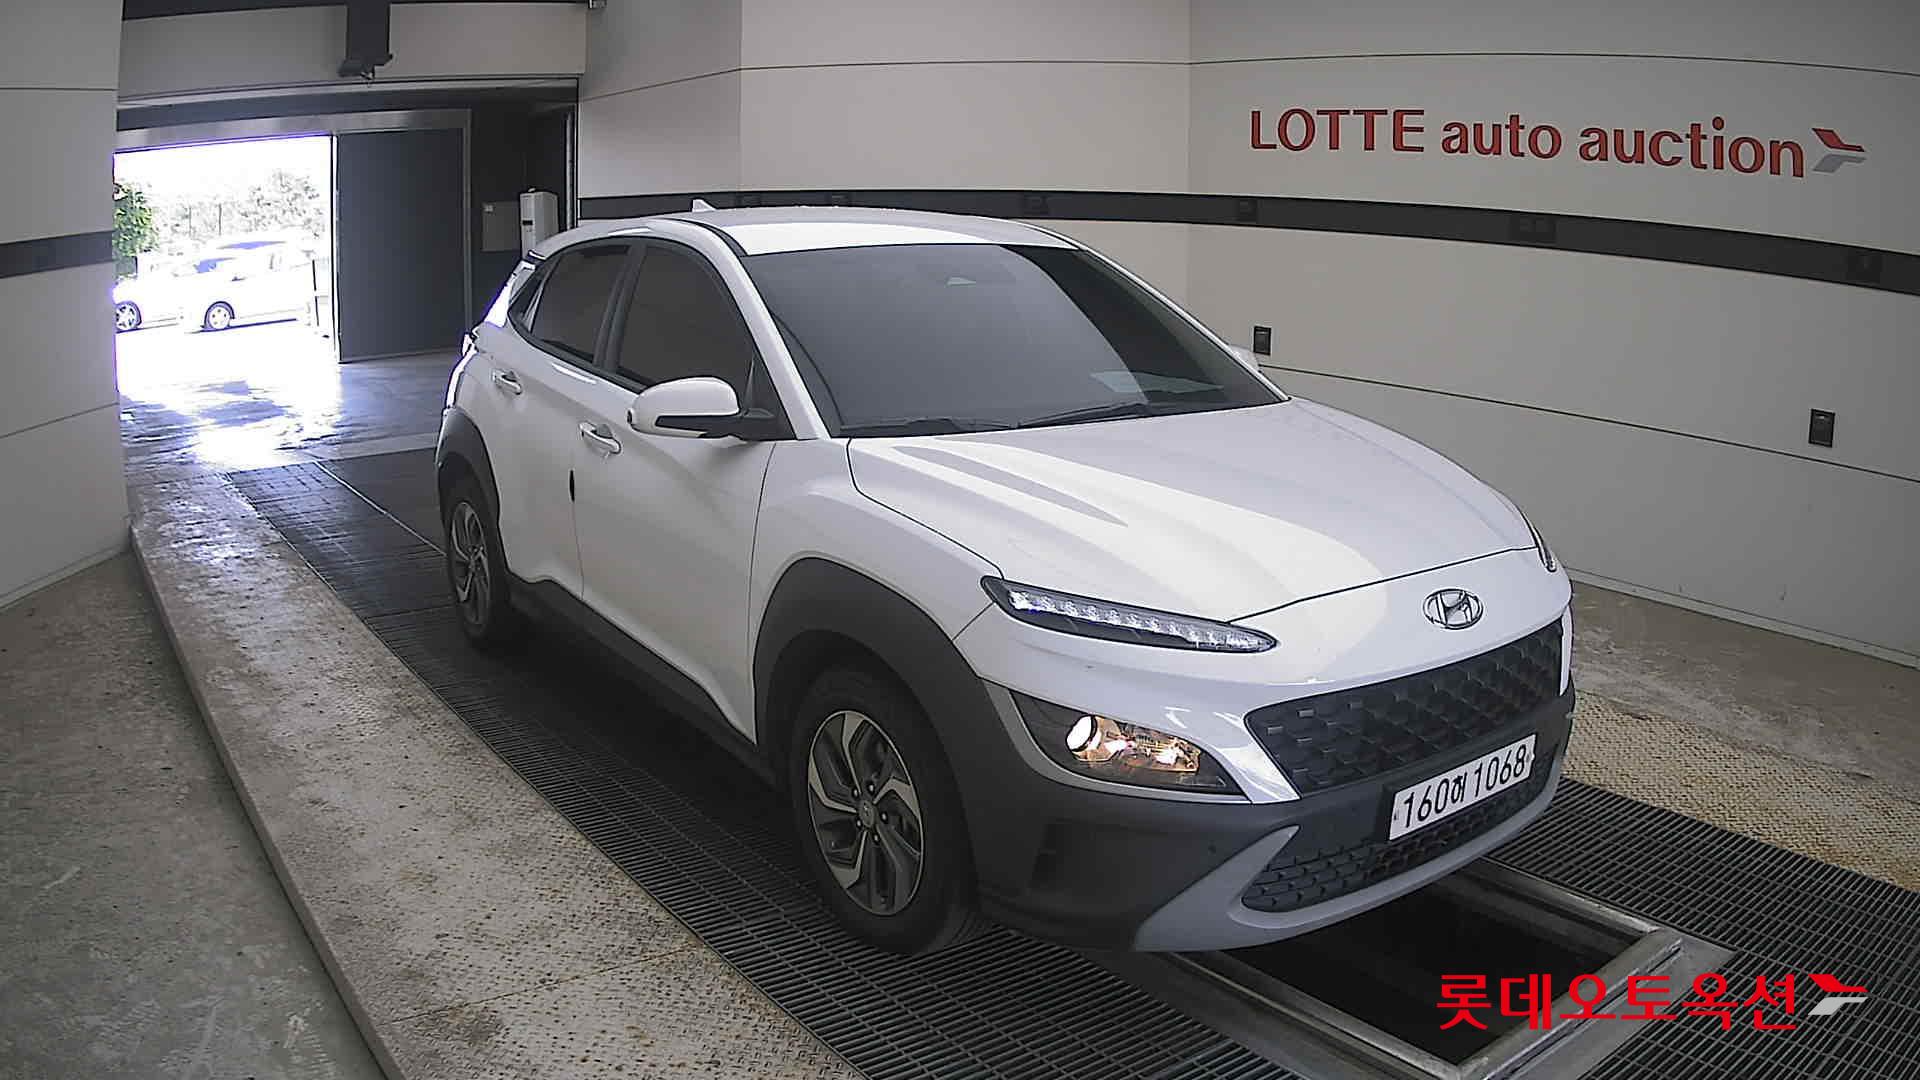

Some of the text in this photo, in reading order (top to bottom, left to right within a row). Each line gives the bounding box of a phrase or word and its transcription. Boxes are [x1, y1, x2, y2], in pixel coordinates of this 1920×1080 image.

[1250, 109, 1806, 178] LOTTE auto auction
[1474, 744, 1527, 798] 1068
